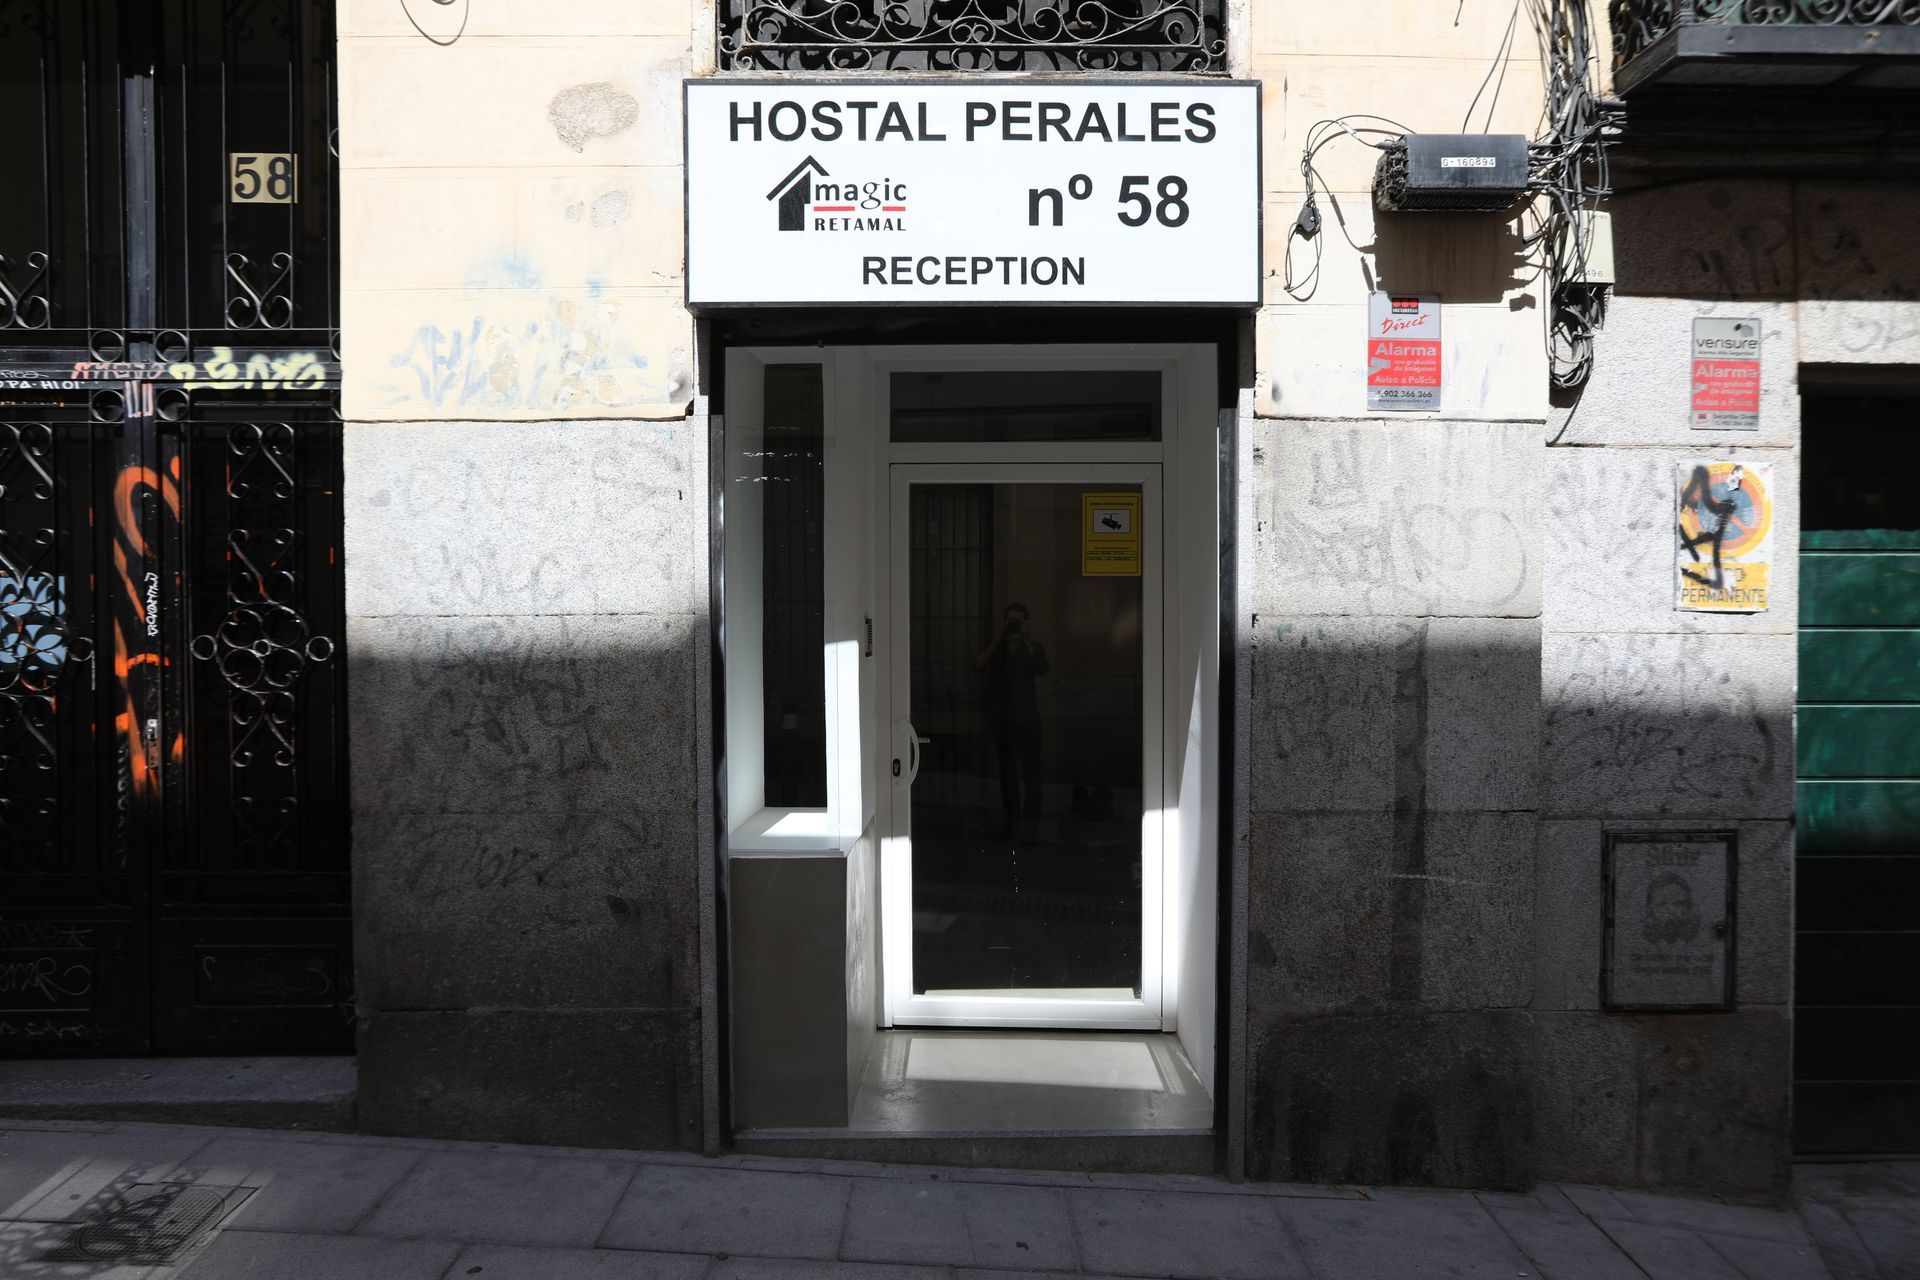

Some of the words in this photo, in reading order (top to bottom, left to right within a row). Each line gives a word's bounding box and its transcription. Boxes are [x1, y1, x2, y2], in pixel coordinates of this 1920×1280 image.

[729, 100, 947, 143] HOSTAL
[965, 100, 1217, 144] PERALES
[234, 156, 293, 200] 58
[815, 177, 907, 210] magic
[1117, 175, 1190, 228] 58
[815, 217, 907, 231] RETAMAL
[862, 256, 1085, 286] RECEPTION
[1380, 314, 1432, 334] Direct
[1376, 342, 1437, 356] Alarma
[1696, 338, 1759, 349] verisure
[1696, 364, 1757, 378] Alarma
[1374, 375, 1399, 384] Aviso
[1408, 375, 1437, 384] Policía
[1383, 390, 1399, 398] 902
[1401, 390, 1416, 398] 366
[1418, 390, 1433, 398] 366
[1681, 588, 1767, 604] PERMANENTE
